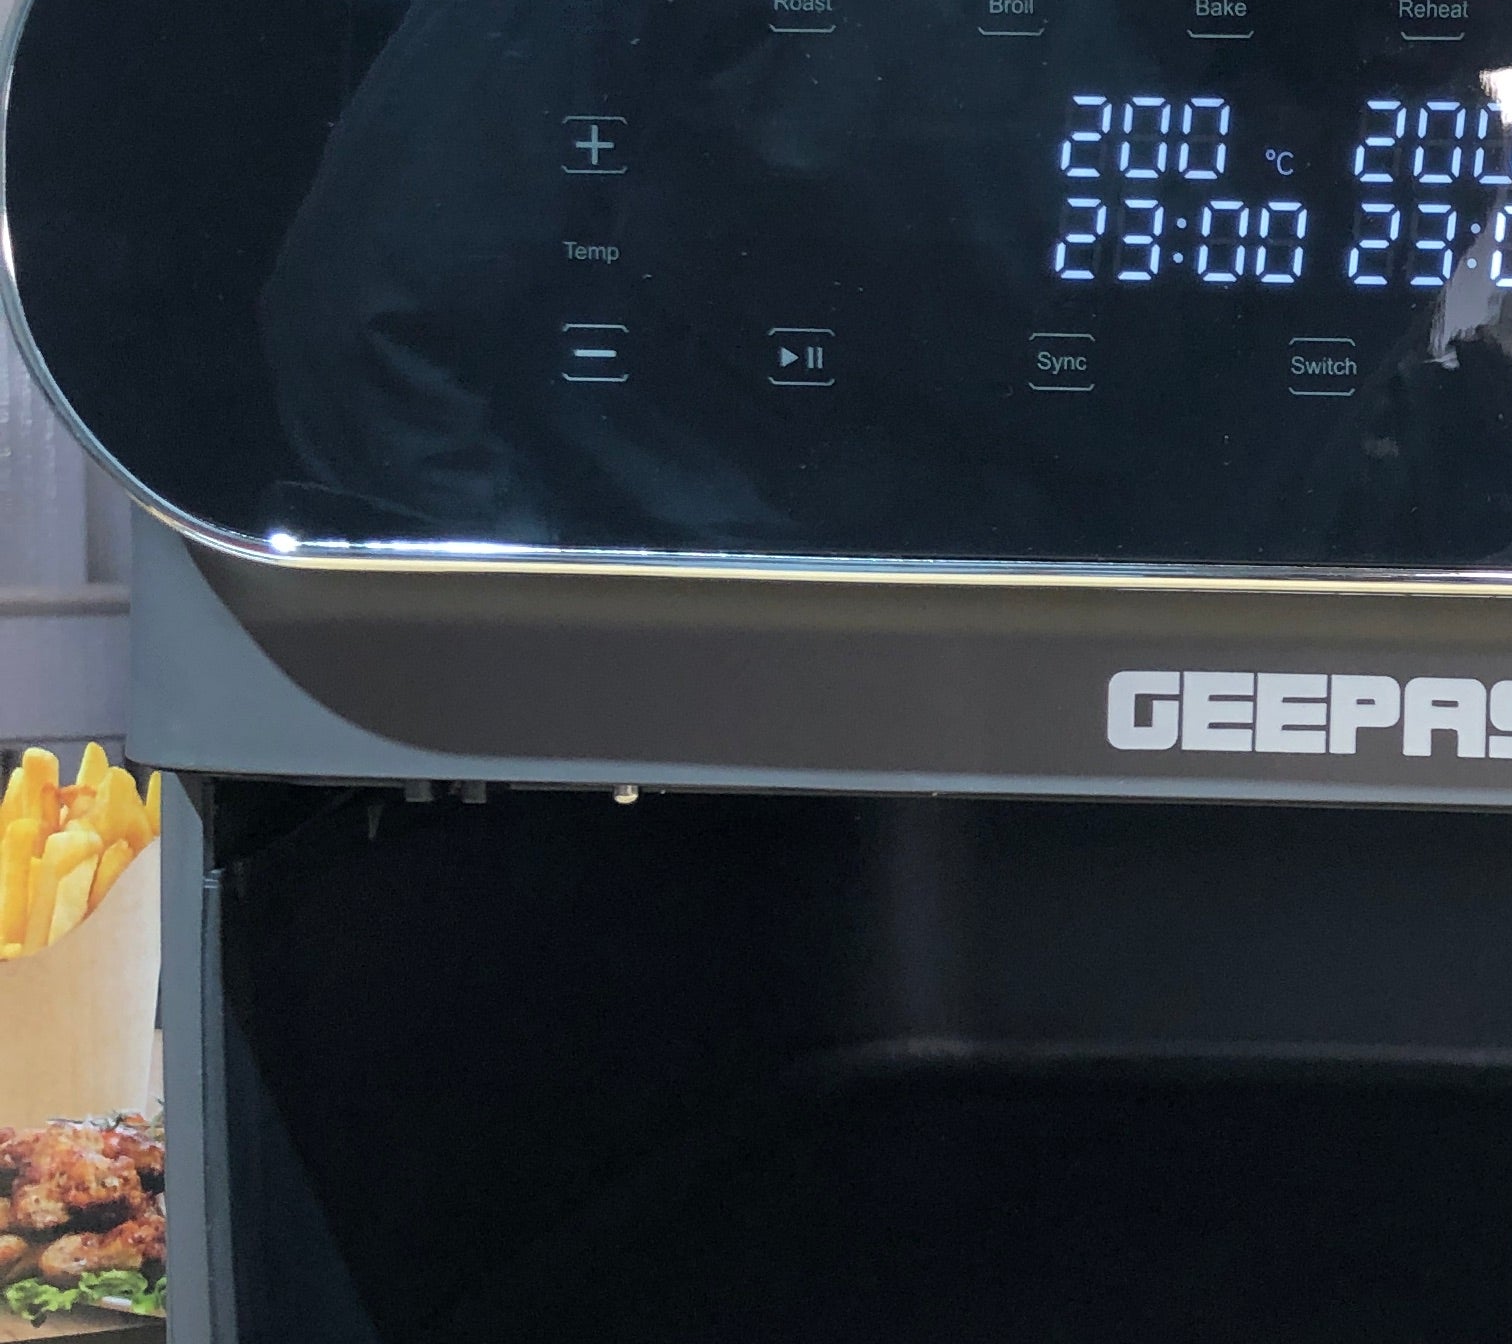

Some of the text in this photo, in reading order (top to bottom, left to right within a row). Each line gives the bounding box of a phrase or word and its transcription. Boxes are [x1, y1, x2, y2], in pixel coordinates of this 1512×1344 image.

[1398, 0, 1469, 19] Reheat
[1061, 95, 1231, 180] 200
[1054, 197, 1308, 284] 23:00
[563, 241, 620, 264] Temp
[1037, 351, 1087, 374] Sync
[1290, 356, 1357, 376] Switch
